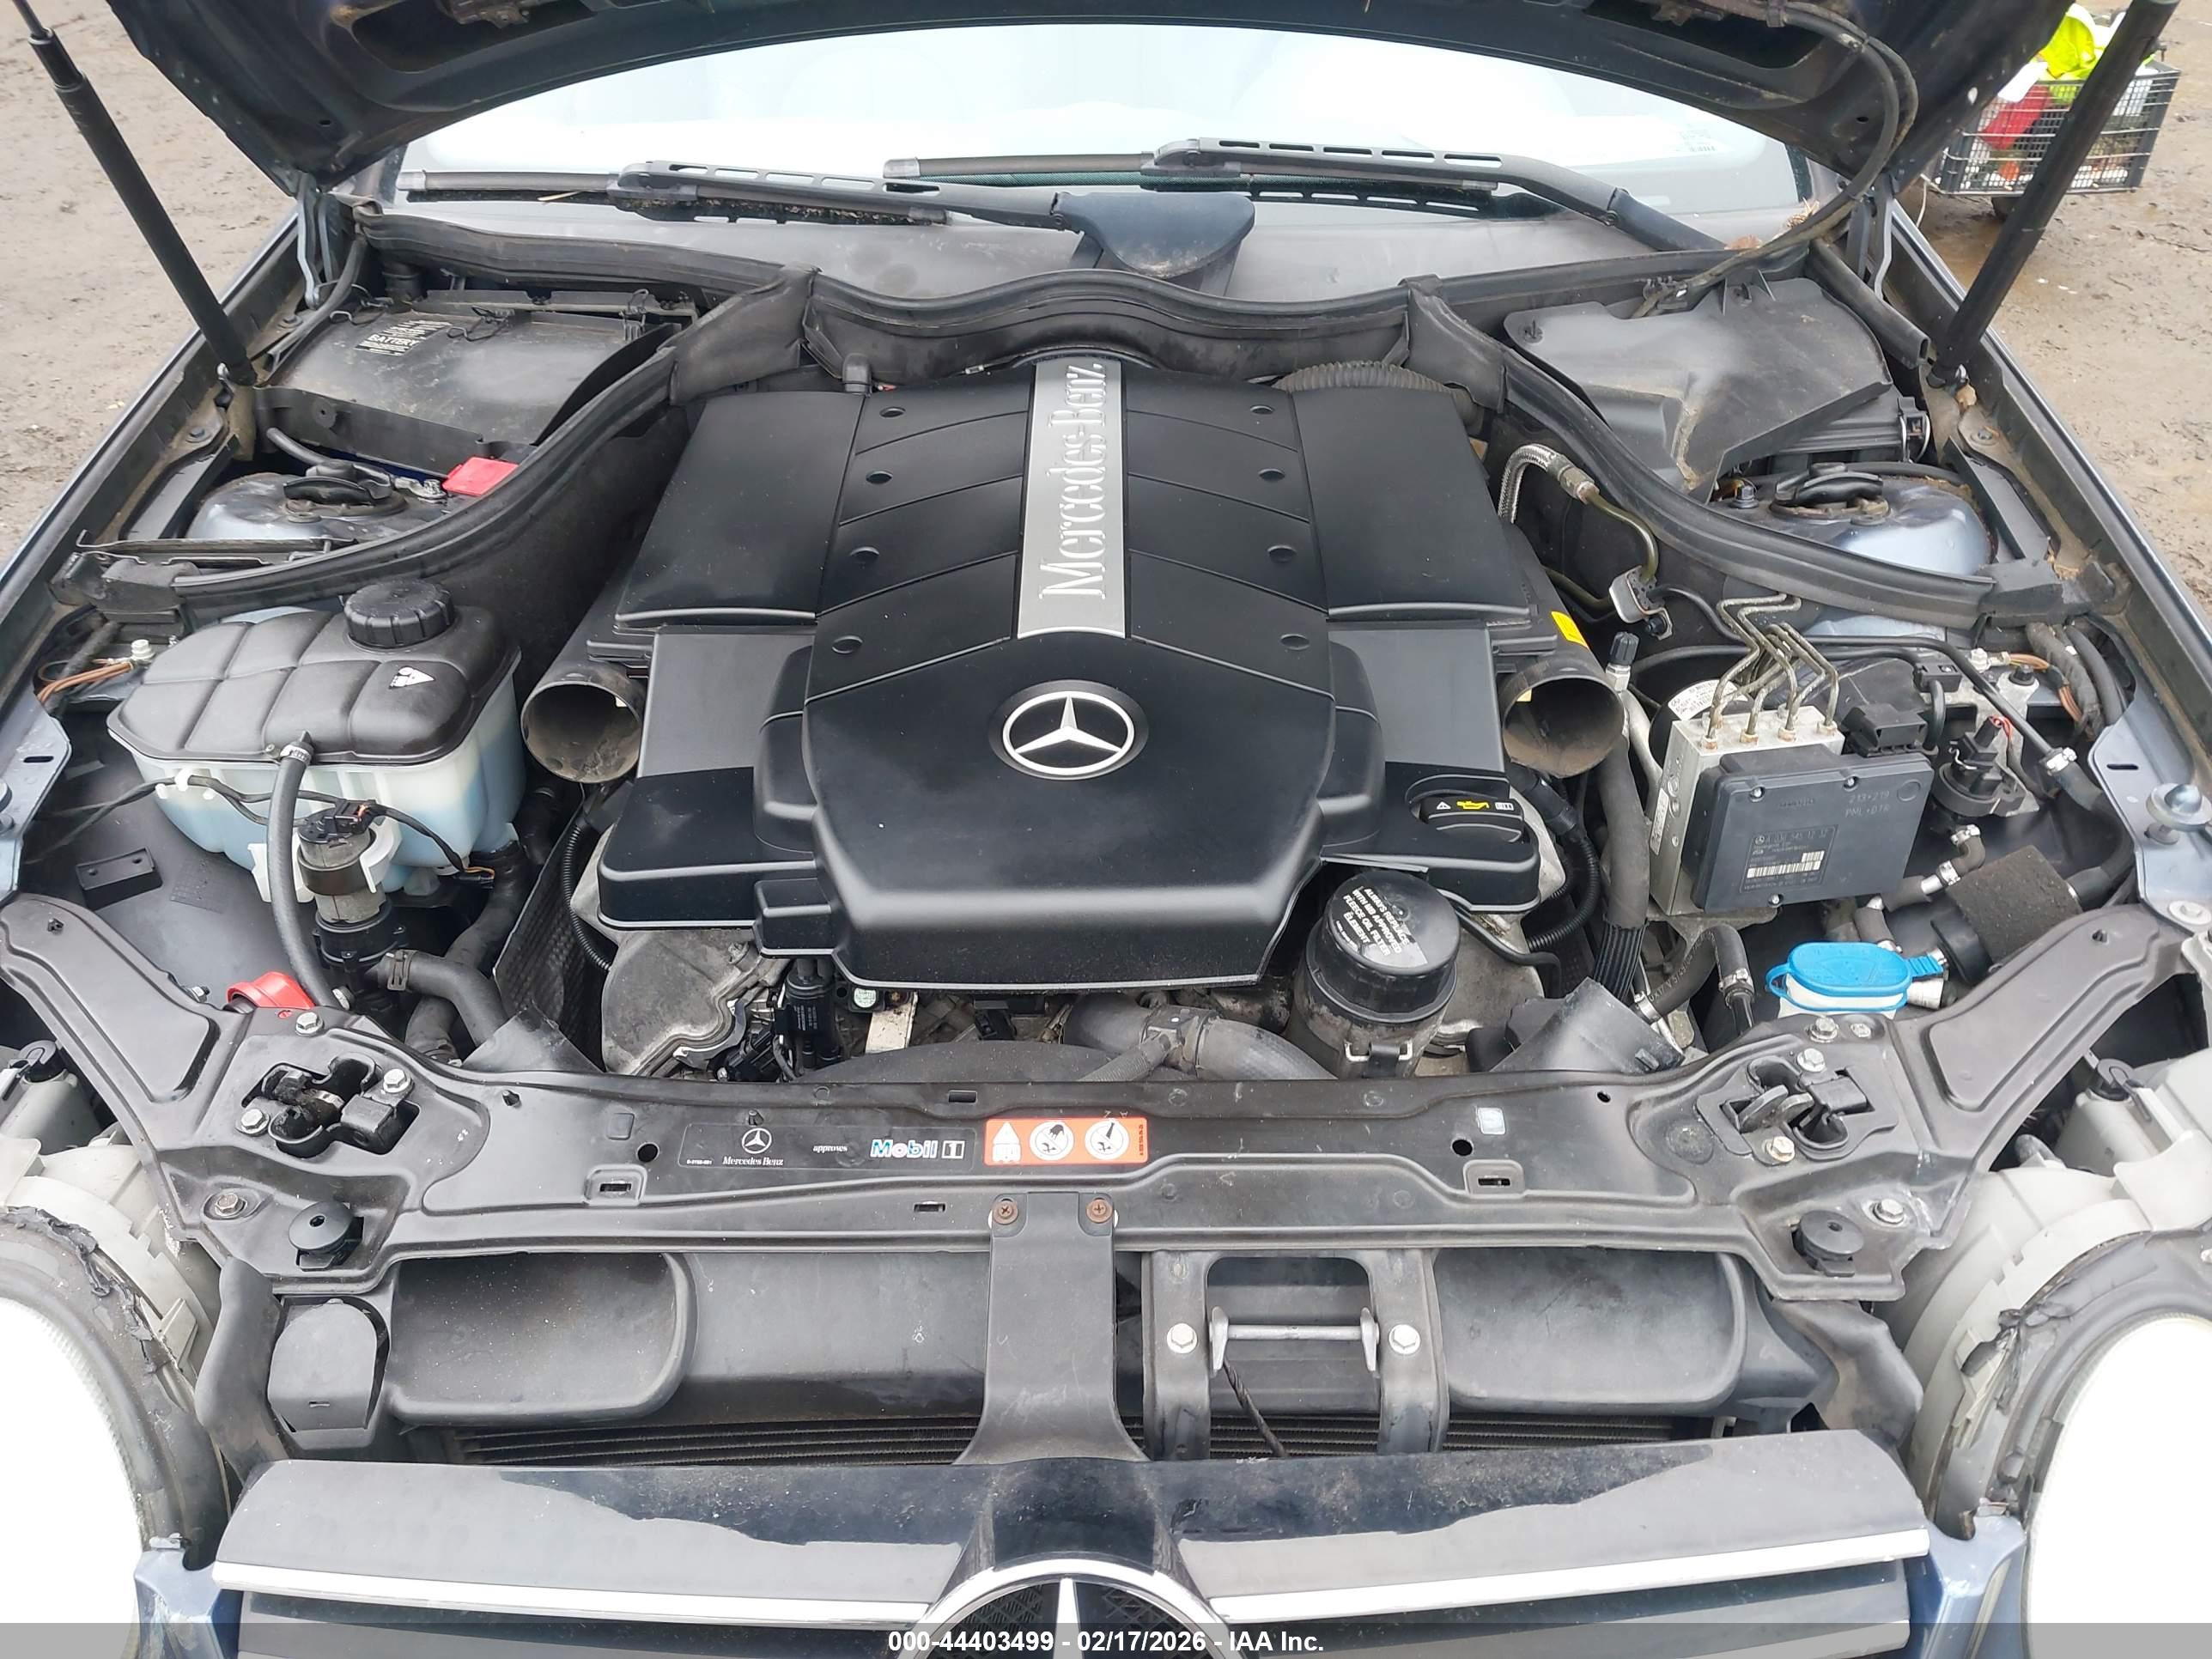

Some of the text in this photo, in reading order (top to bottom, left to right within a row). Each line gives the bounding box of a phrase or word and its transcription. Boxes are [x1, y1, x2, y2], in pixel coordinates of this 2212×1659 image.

[1038, 362, 1107, 599] Mercedes-Benz
[1343, 895, 1366, 920] FLEECE
[1362, 917, 1374, 932] OIL
[1370, 929, 1391, 956] FILTER
[1343, 912, 1370, 944] ELEMENT
[1352, 889, 1402, 954] WITH MB APPROVED
[1364, 888, 1410, 945] ALWAYS REPLACE
[722, 1156, 763, 1165] Mercedes
[763, 1157, 784, 1166] Benz
[812, 1145, 848, 1153] approves
[870, 1139, 939, 1158] Mobil
